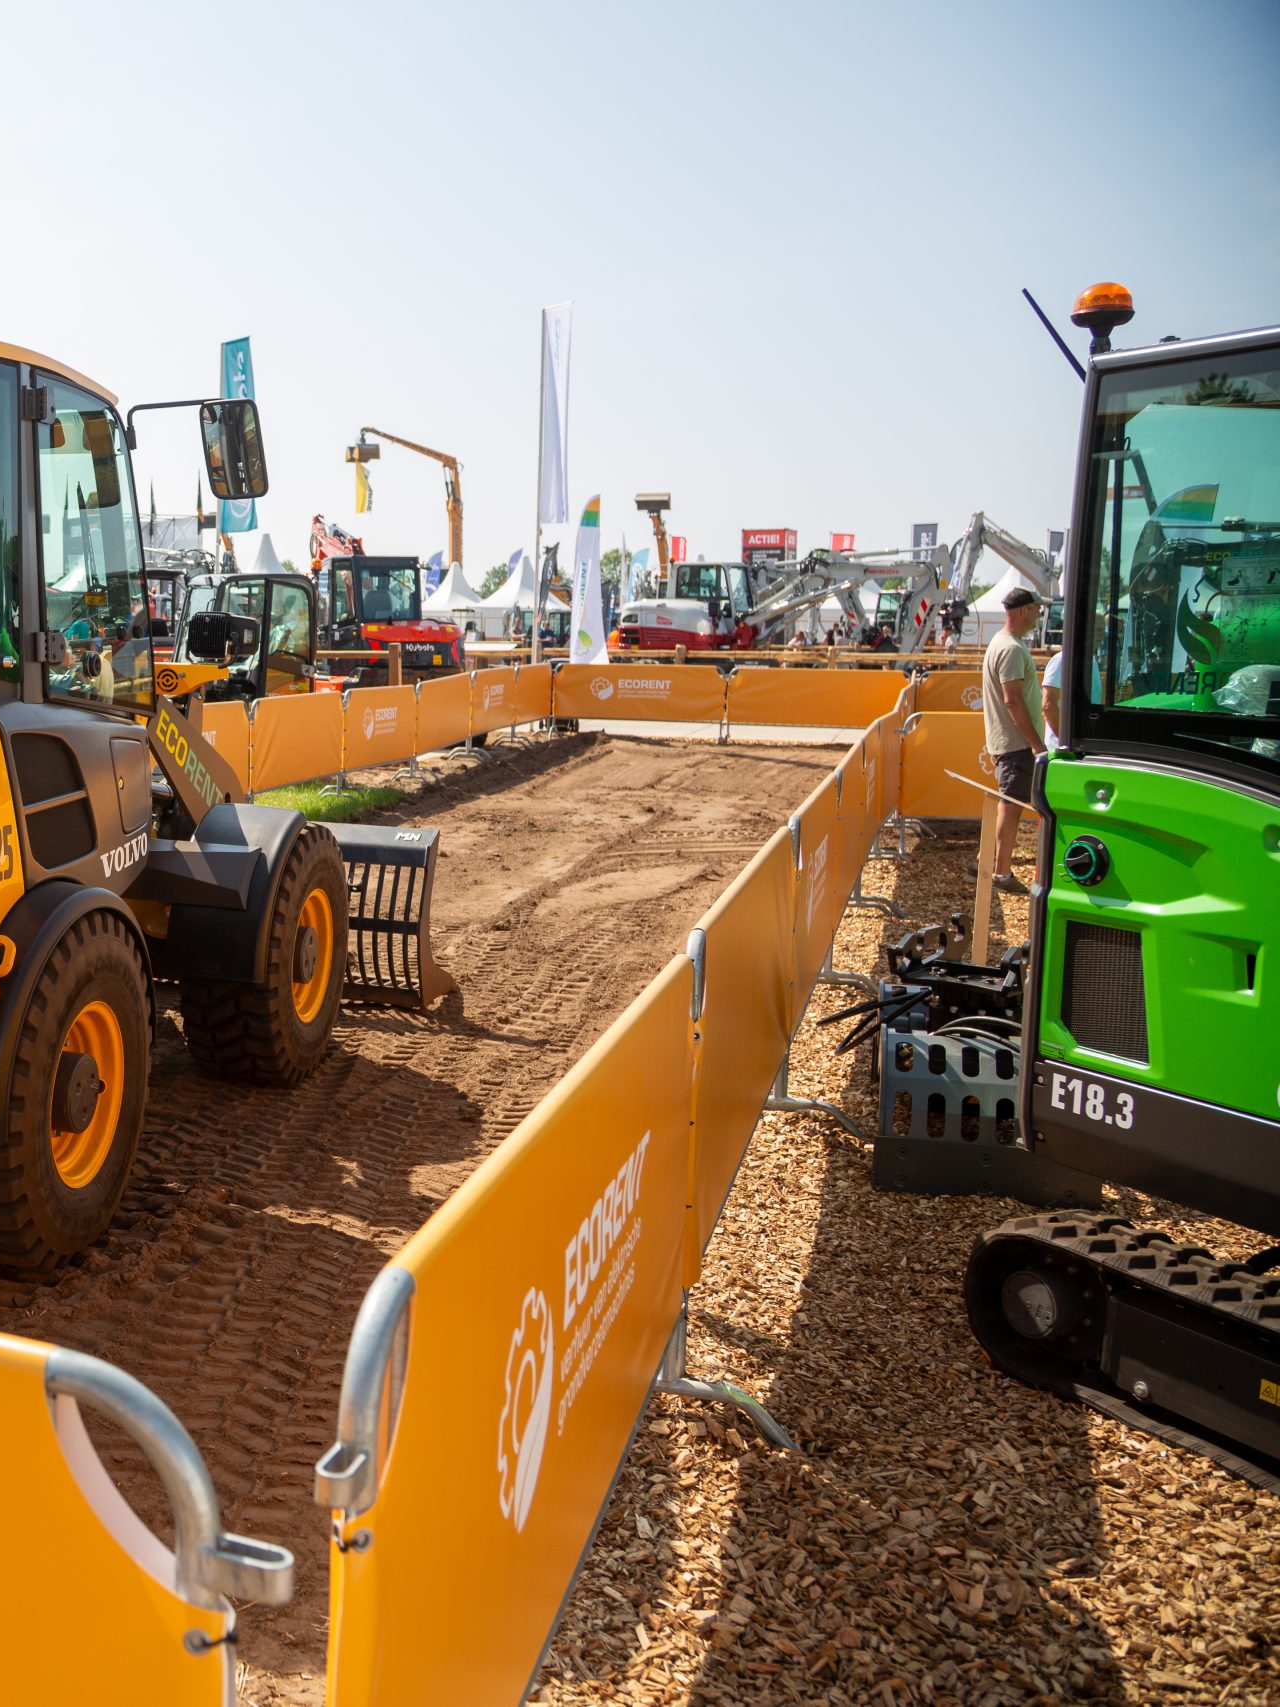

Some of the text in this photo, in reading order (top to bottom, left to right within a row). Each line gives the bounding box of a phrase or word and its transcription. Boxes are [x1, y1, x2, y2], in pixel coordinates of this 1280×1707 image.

[749, 534, 780, 545] ACTIE!
[406, 643, 435, 652] Kubota
[617, 679, 672, 689] ECORENT
[156, 709, 223, 807] ECORENT
[100, 833, 148, 878] VOLVO
[1051, 1072, 1134, 1130] E18.3
[563, 1129, 650, 1331] ECORENT
[561, 1216, 641, 1382] verhuur van elektrische
